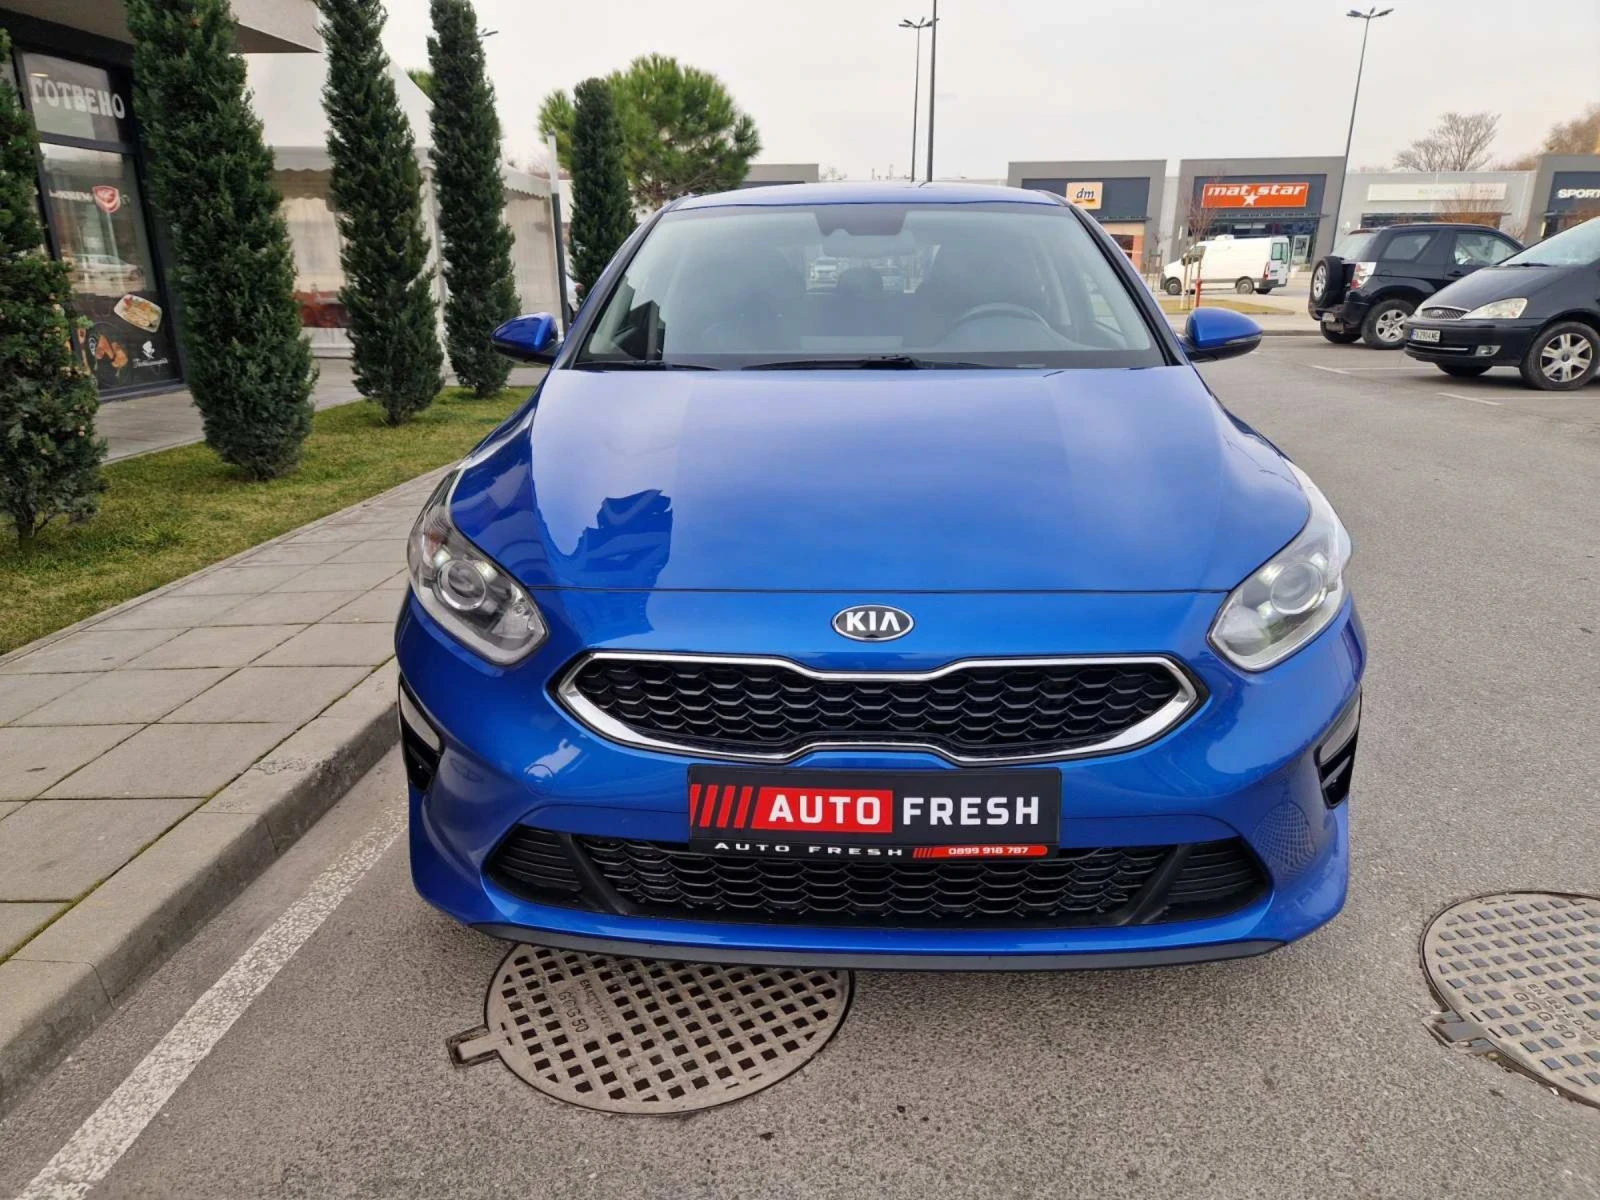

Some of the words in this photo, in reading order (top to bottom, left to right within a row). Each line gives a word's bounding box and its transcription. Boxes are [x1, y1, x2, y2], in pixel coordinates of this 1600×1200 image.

[29, 77, 125, 119] ГОТВЕНО
[1076, 187, 1095, 199] dm
[1207, 185, 1251, 196] mat
[1256, 184, 1306, 196] star
[845, 611, 900, 632] KIA
[768, 794, 881, 826] AUTO
[902, 796, 1039, 826] FRESH
[714, 841, 790, 853] AUTO
[808, 846, 902, 857] FRESH
[948, 847, 979, 855] 0899
[1513, 992, 1554, 1022] GGG
